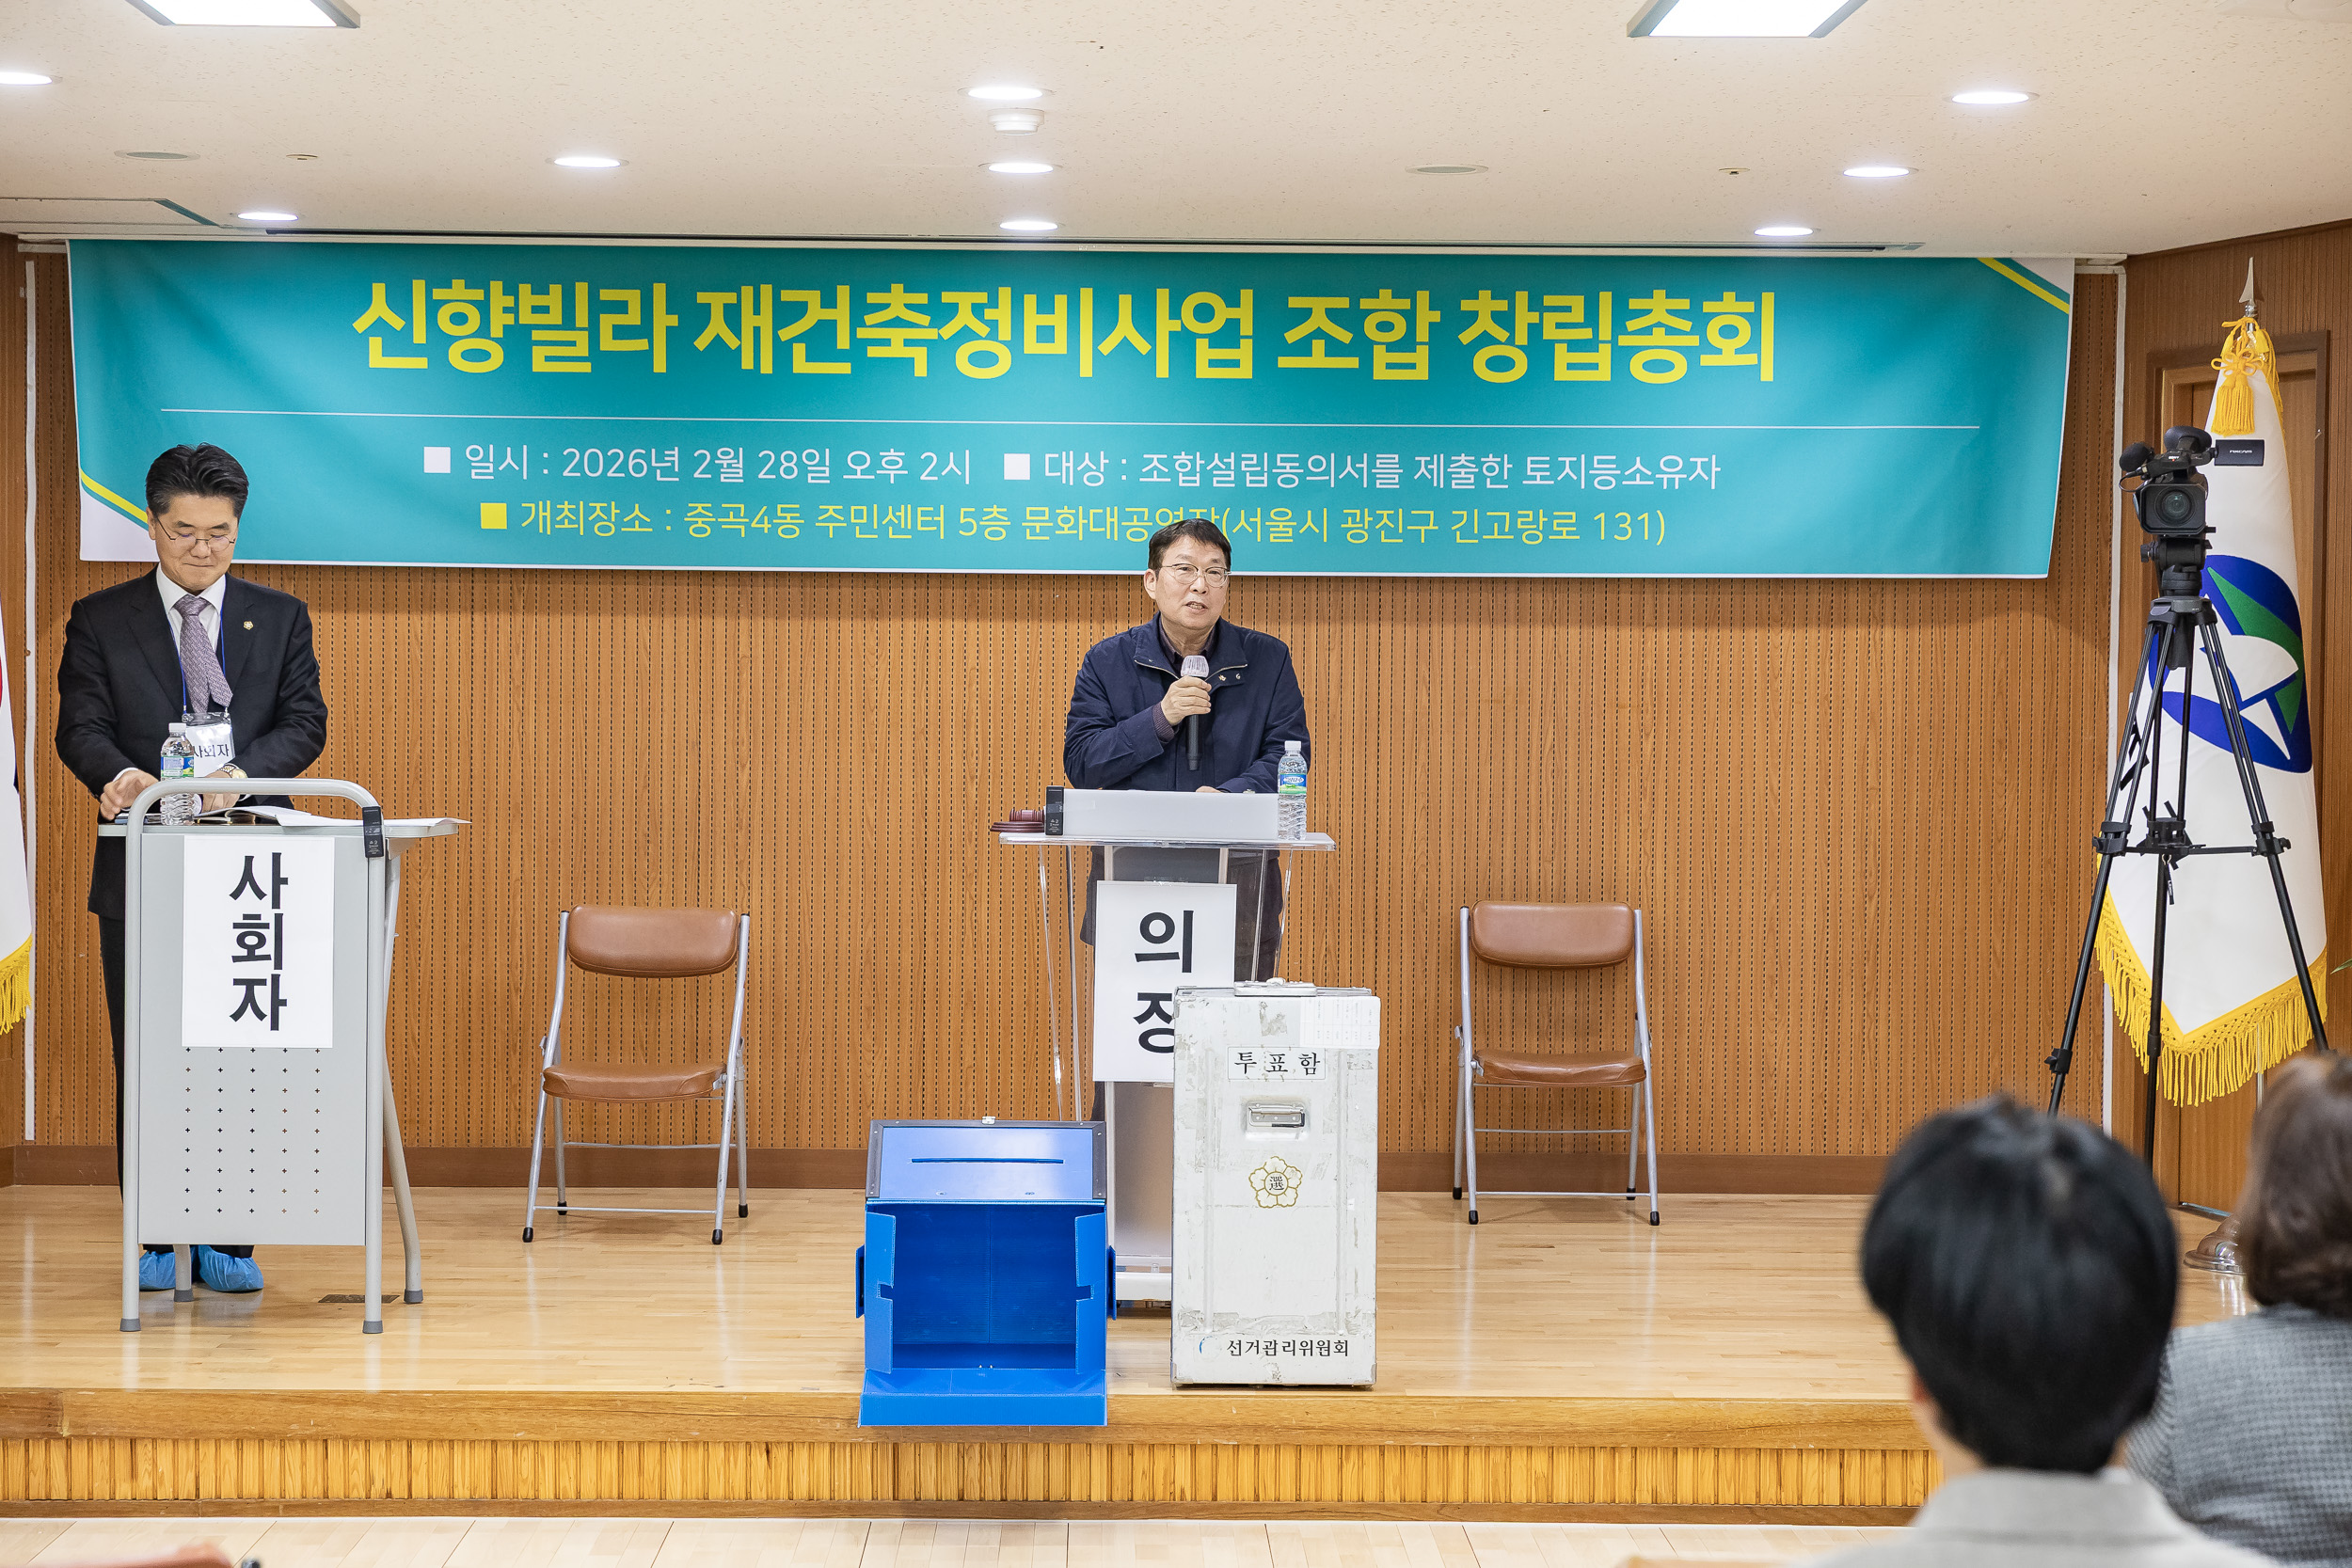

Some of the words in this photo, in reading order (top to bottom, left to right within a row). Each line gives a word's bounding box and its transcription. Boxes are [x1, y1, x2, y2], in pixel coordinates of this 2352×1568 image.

[353, 279, 677, 373] 신향빌라
[694, 283, 1253, 379] 재건축정비사업
[1278, 289, 1440, 380] 조합
[1457, 290, 1774, 385] 창립총회
[466, 445, 528, 480] 일시
[564, 446, 679, 482] 2026년
[694, 447, 744, 483] 2월
[757, 448, 830, 483] 28일
[843, 449, 909, 484] 오후
[919, 449, 970, 485] 2시
[1044, 451, 1109, 487] 대상
[1139, 451, 1403, 489] 조합설립동의서를
[1413, 452, 1512, 489] 제출한
[1522, 453, 1721, 491] 토지등소유자
[521, 499, 653, 537] 개최장소
[684, 502, 805, 539] 중곡4동
[816, 504, 945, 540] 주민센터
[958, 504, 1010, 542] 5층
[1341, 508, 1438, 544] 광진구
[1452, 508, 1581, 546] 긴고랑로
[1594, 511, 1665, 546] 131)
[229, 851, 289, 1032] 사회자
[1234, 1052, 1321, 1076] 투표함
[1227, 1339, 1349, 1357] 선거관리위원회
